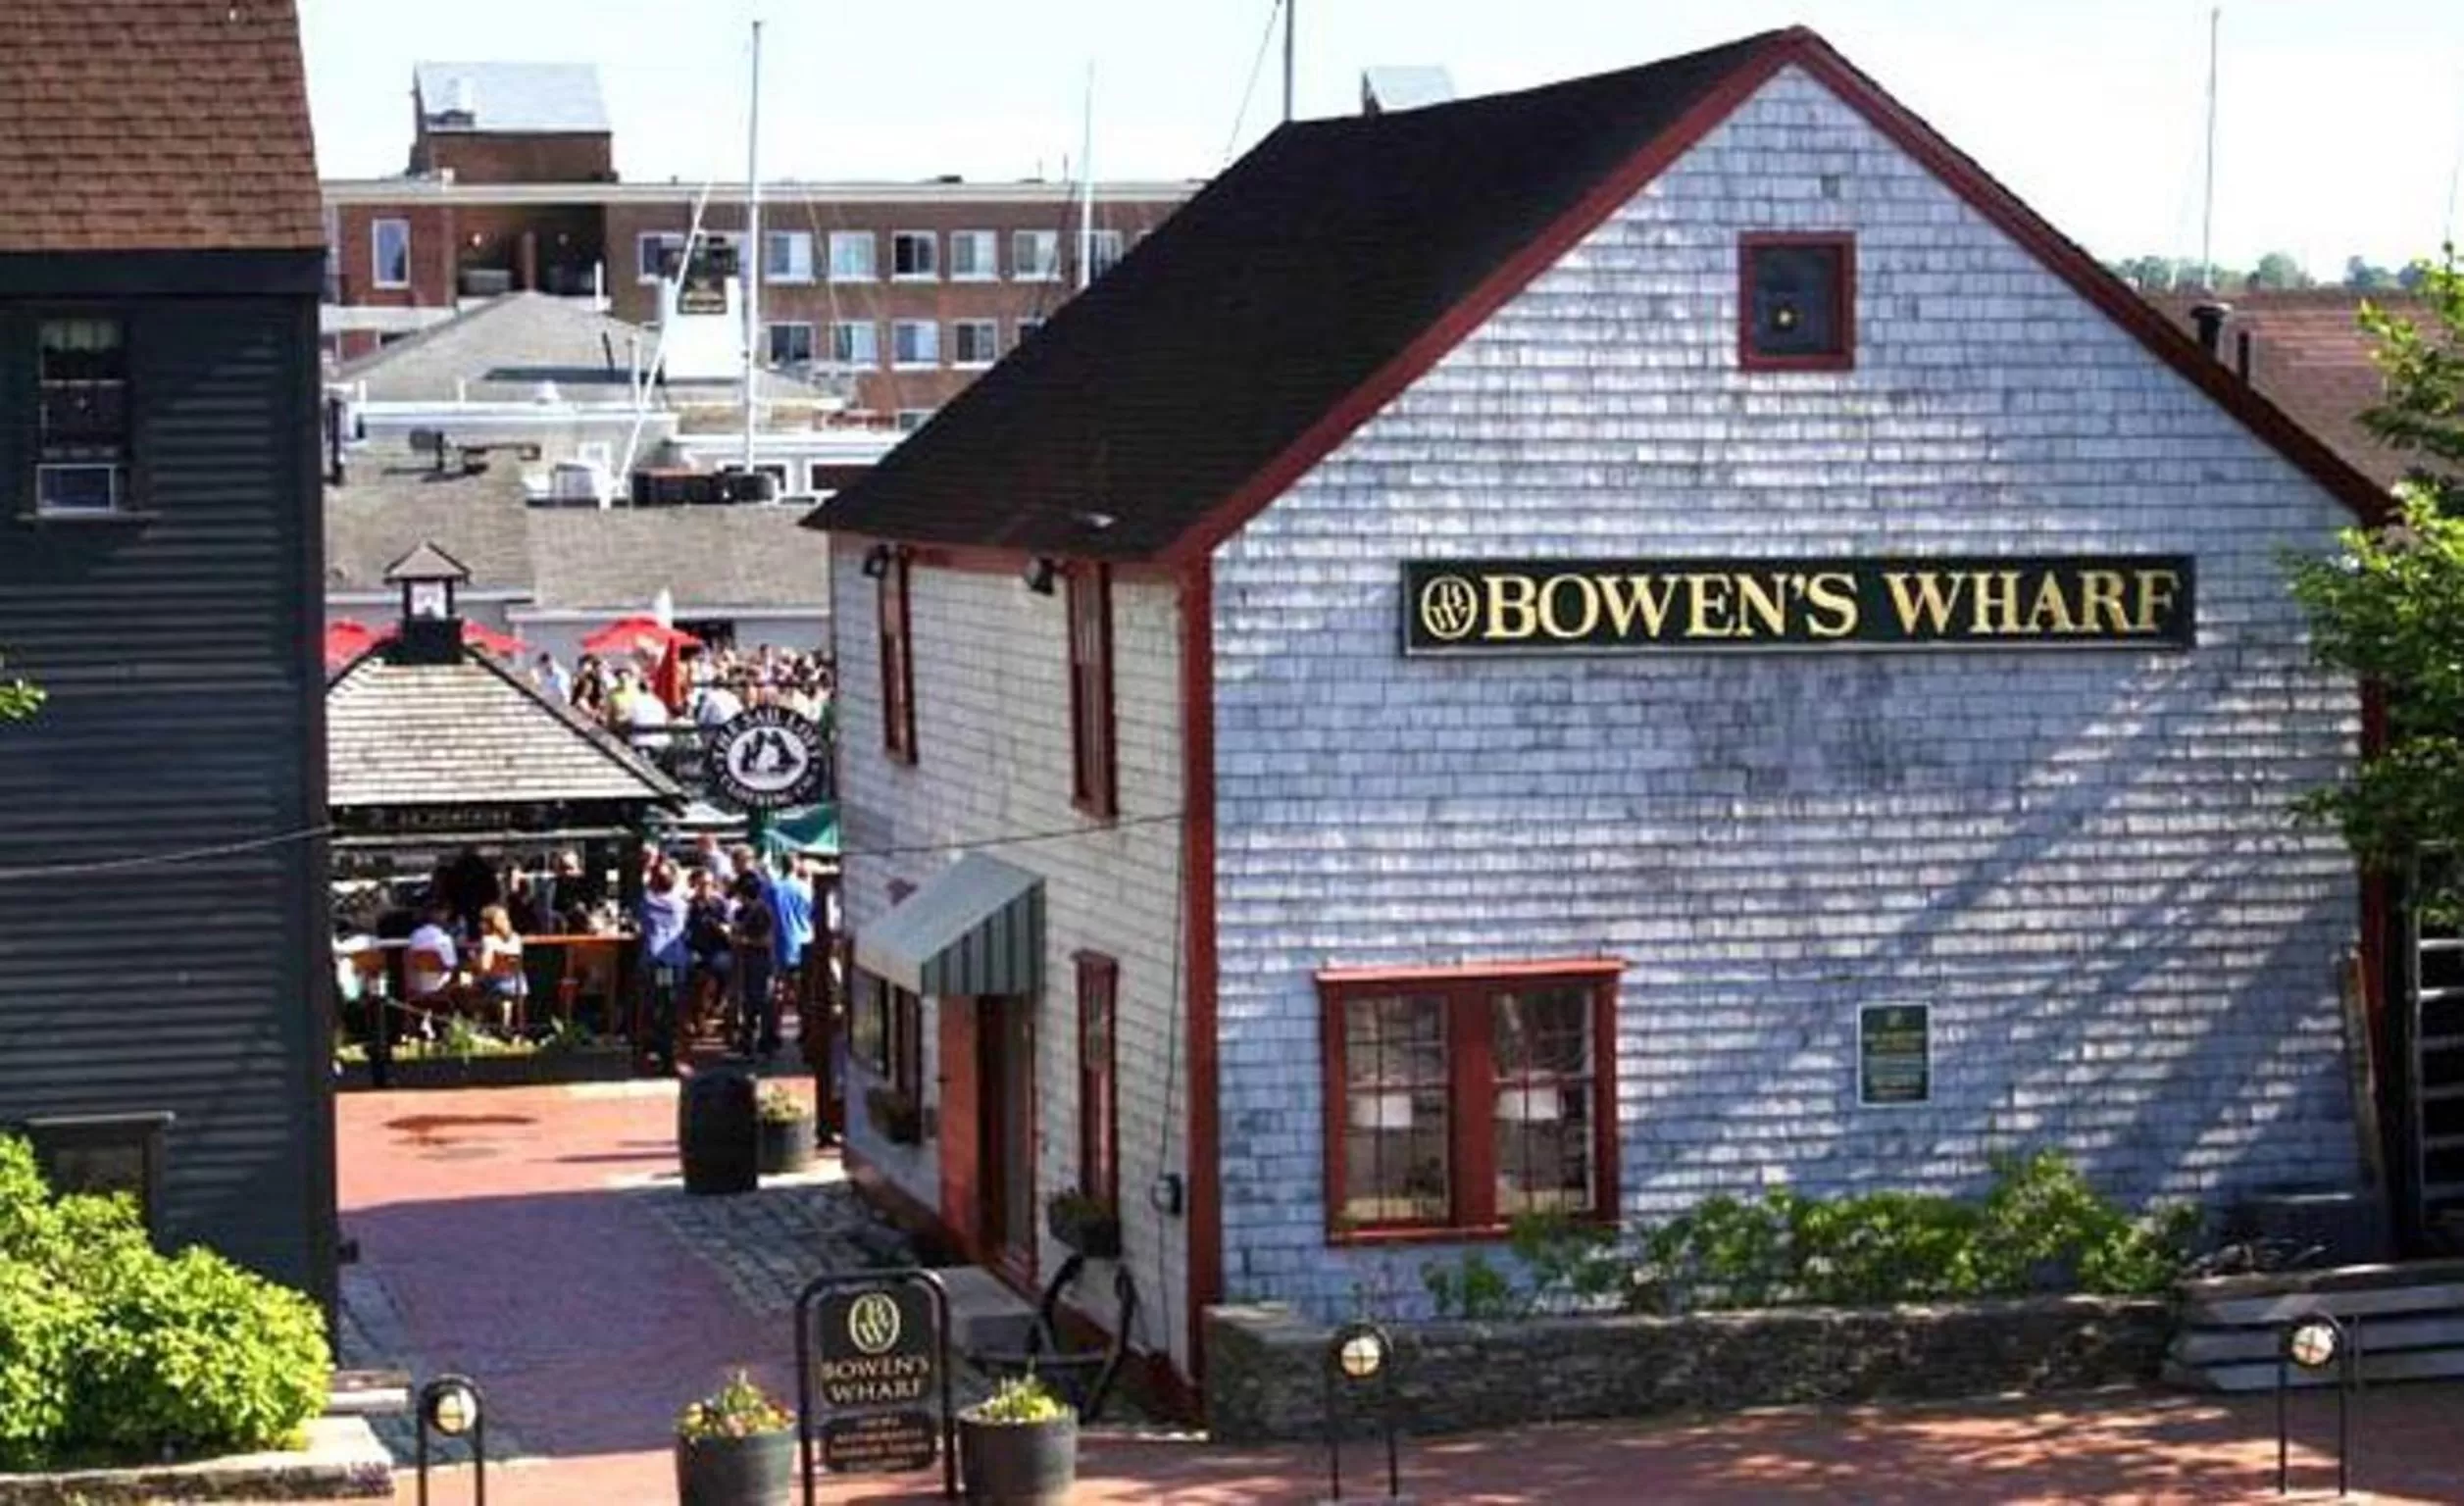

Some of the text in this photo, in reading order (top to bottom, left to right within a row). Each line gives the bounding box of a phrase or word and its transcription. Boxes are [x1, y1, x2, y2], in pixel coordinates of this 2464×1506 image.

[1483, 569, 2181, 638] BOWEN'S WHARF
[830, 1379, 923, 1403] WHARF
